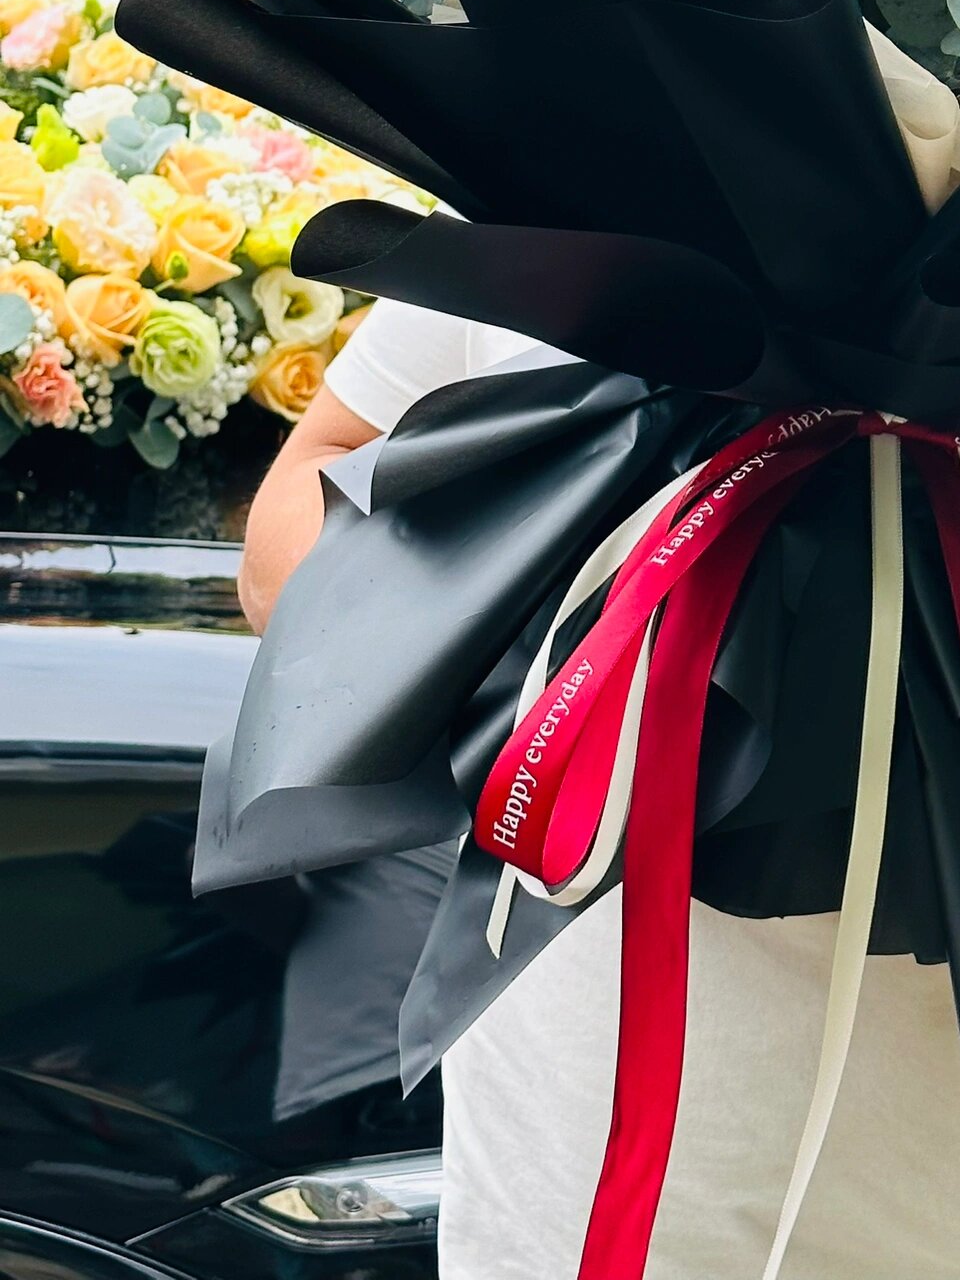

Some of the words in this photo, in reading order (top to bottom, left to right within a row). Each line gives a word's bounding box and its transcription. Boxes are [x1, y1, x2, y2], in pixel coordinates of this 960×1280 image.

[652, 501, 714, 567] Happy
[493, 765, 537, 850] Happy
[525, 658, 594, 767] everyday
